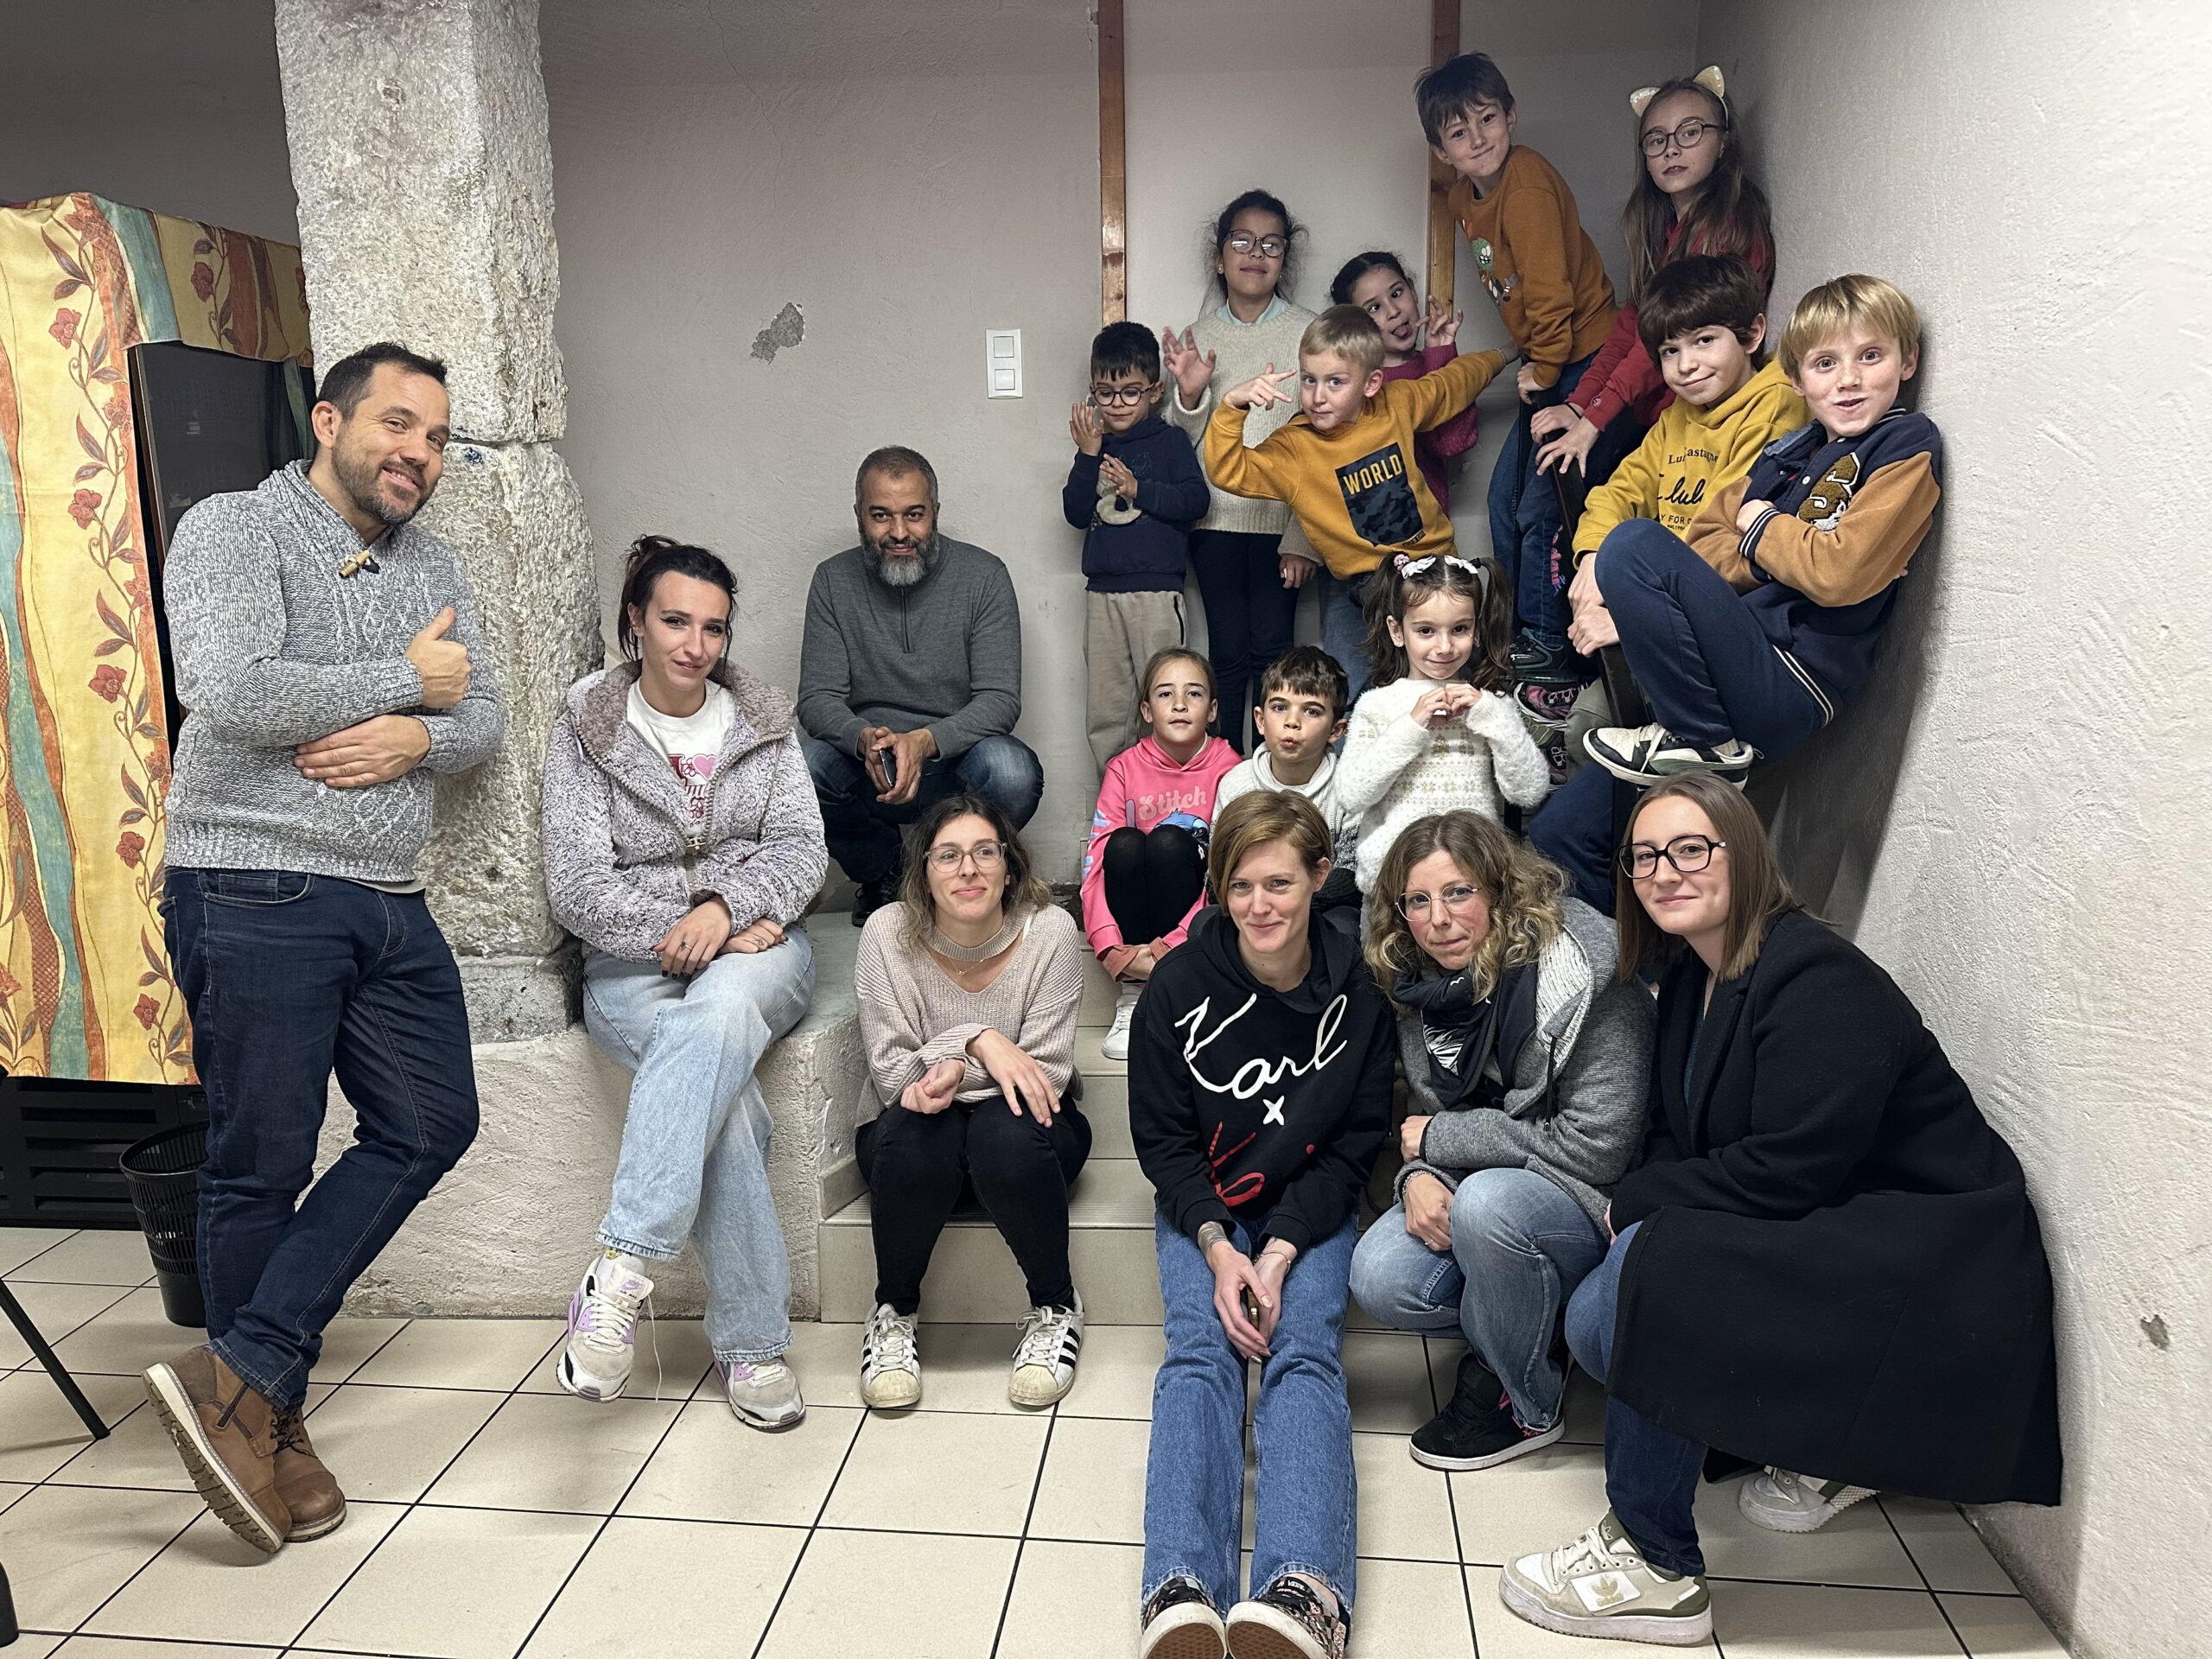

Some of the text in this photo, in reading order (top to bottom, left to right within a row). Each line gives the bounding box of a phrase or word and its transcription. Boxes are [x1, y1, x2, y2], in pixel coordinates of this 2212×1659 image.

[1343, 454, 1402, 495] WORLD
[1668, 515, 1686, 524] FOR
[1138, 785, 1208, 820] Stitch
[1173, 993, 1349, 1100] Karl
